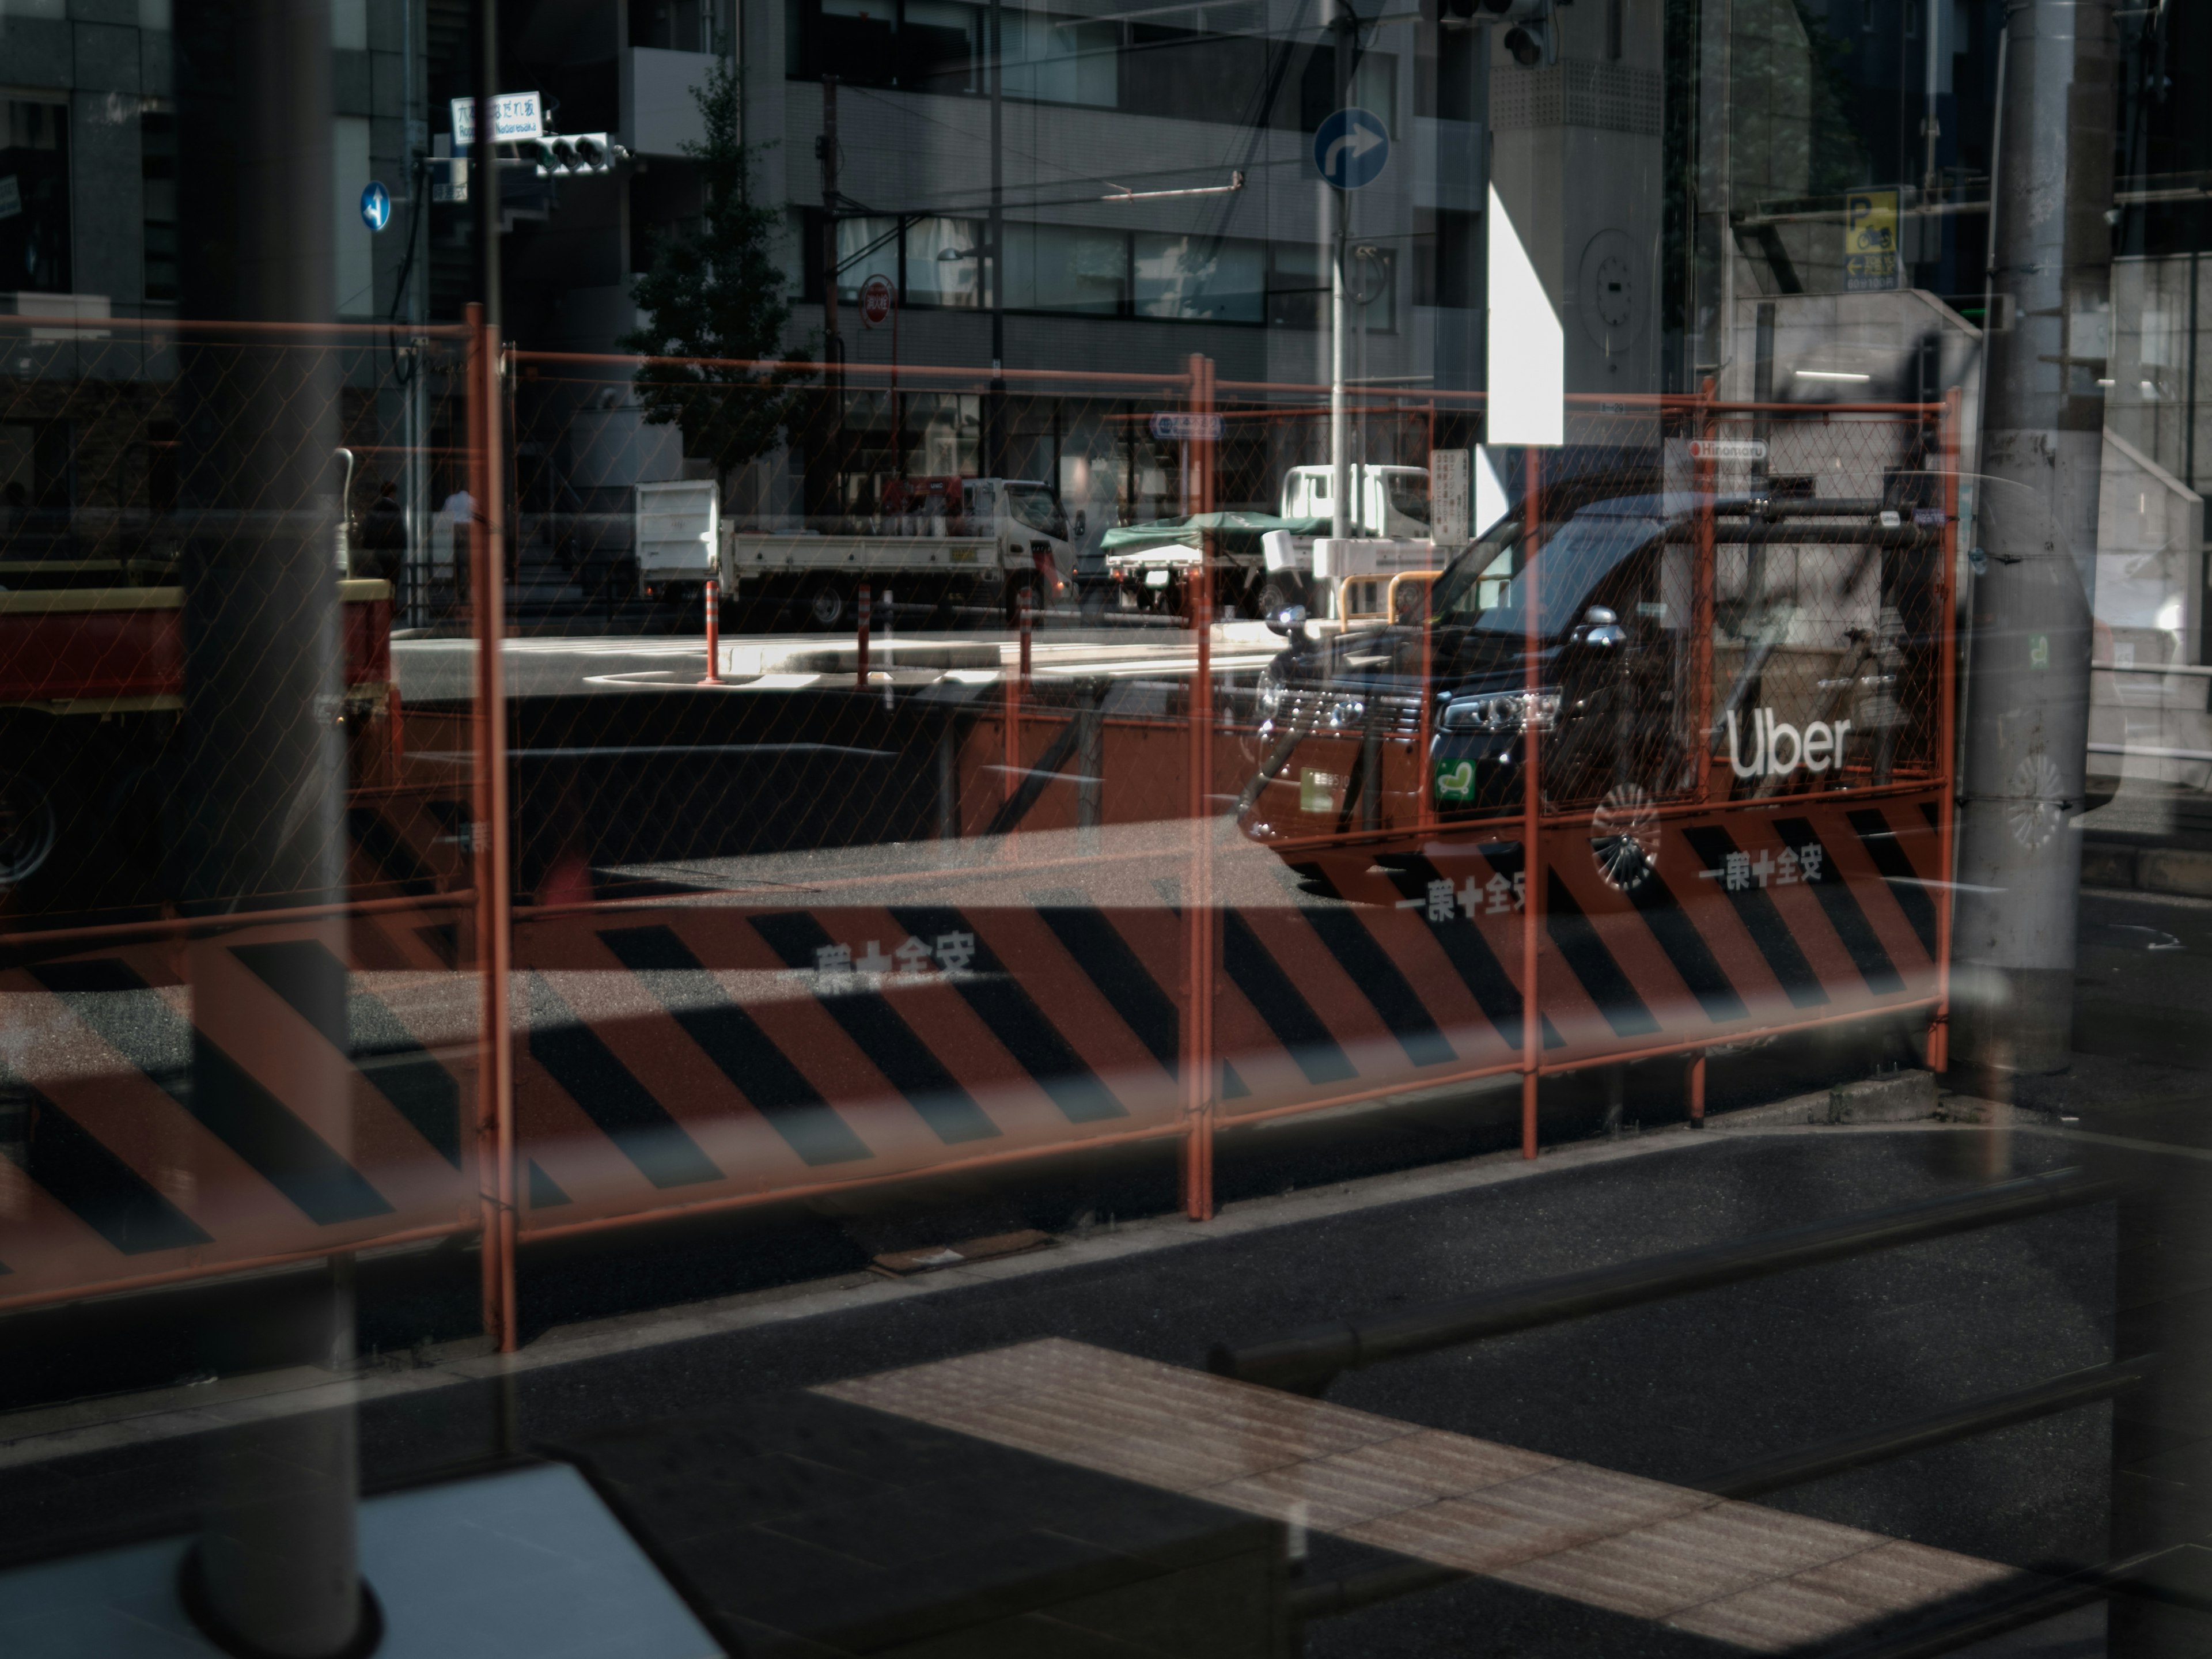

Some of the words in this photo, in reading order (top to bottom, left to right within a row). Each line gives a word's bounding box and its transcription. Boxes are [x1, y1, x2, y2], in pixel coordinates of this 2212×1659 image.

[1851, 198, 1871, 230] P
[866, 293, 888, 310] 消火栓
[1702, 442, 1763, 457] Hinomaru
[1726, 707, 1851, 778] Uber
